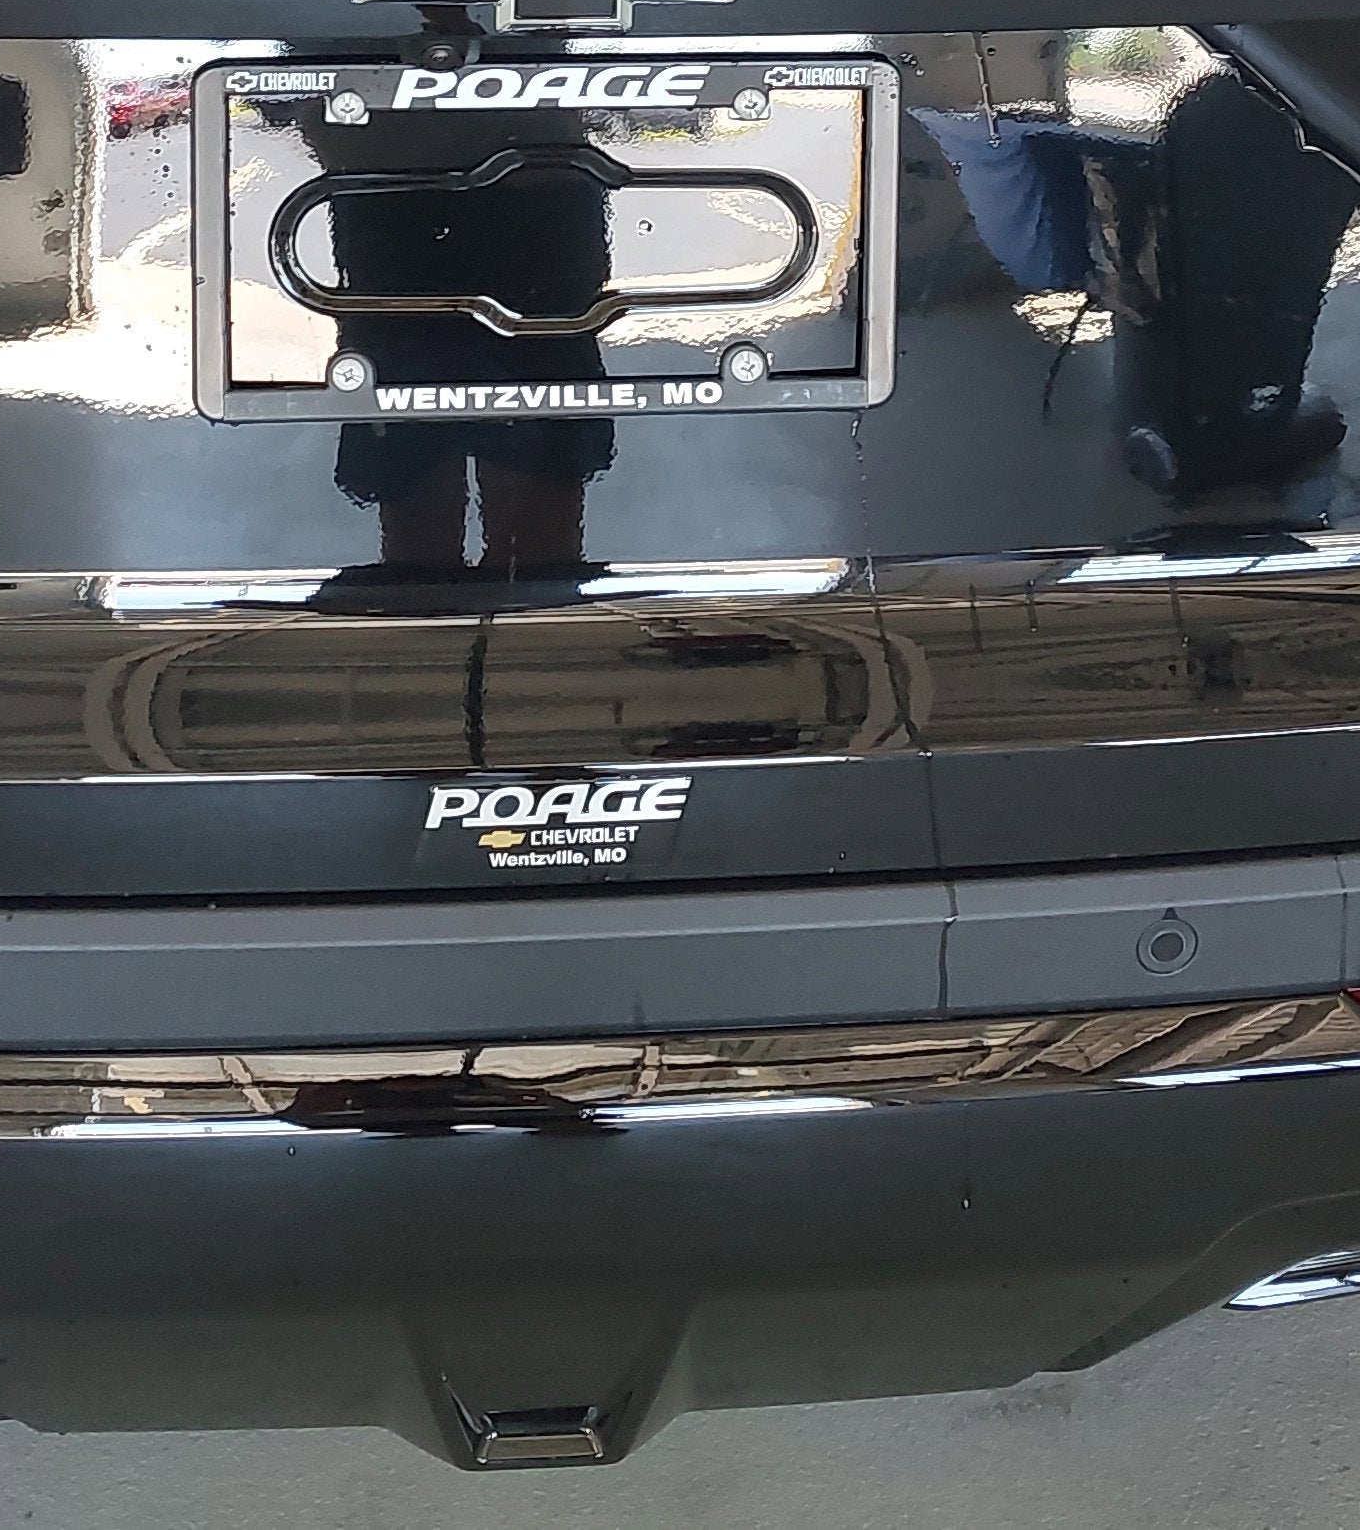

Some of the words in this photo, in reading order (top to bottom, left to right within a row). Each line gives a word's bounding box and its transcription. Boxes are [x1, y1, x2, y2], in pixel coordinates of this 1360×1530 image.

[259, 72, 337, 90] CHEVROLET
[793, 67, 869, 86] CHEVROLET
[392, 66, 709, 108] POAGE
[376, 384, 648, 410] WENTZVILLE,
[662, 380, 723, 406] MO
[425, 777, 692, 828] POAGE
[530, 827, 638, 847] CHEVROLET
[488, 849, 590, 868] Wentzville,
[594, 848, 627, 864] MO
